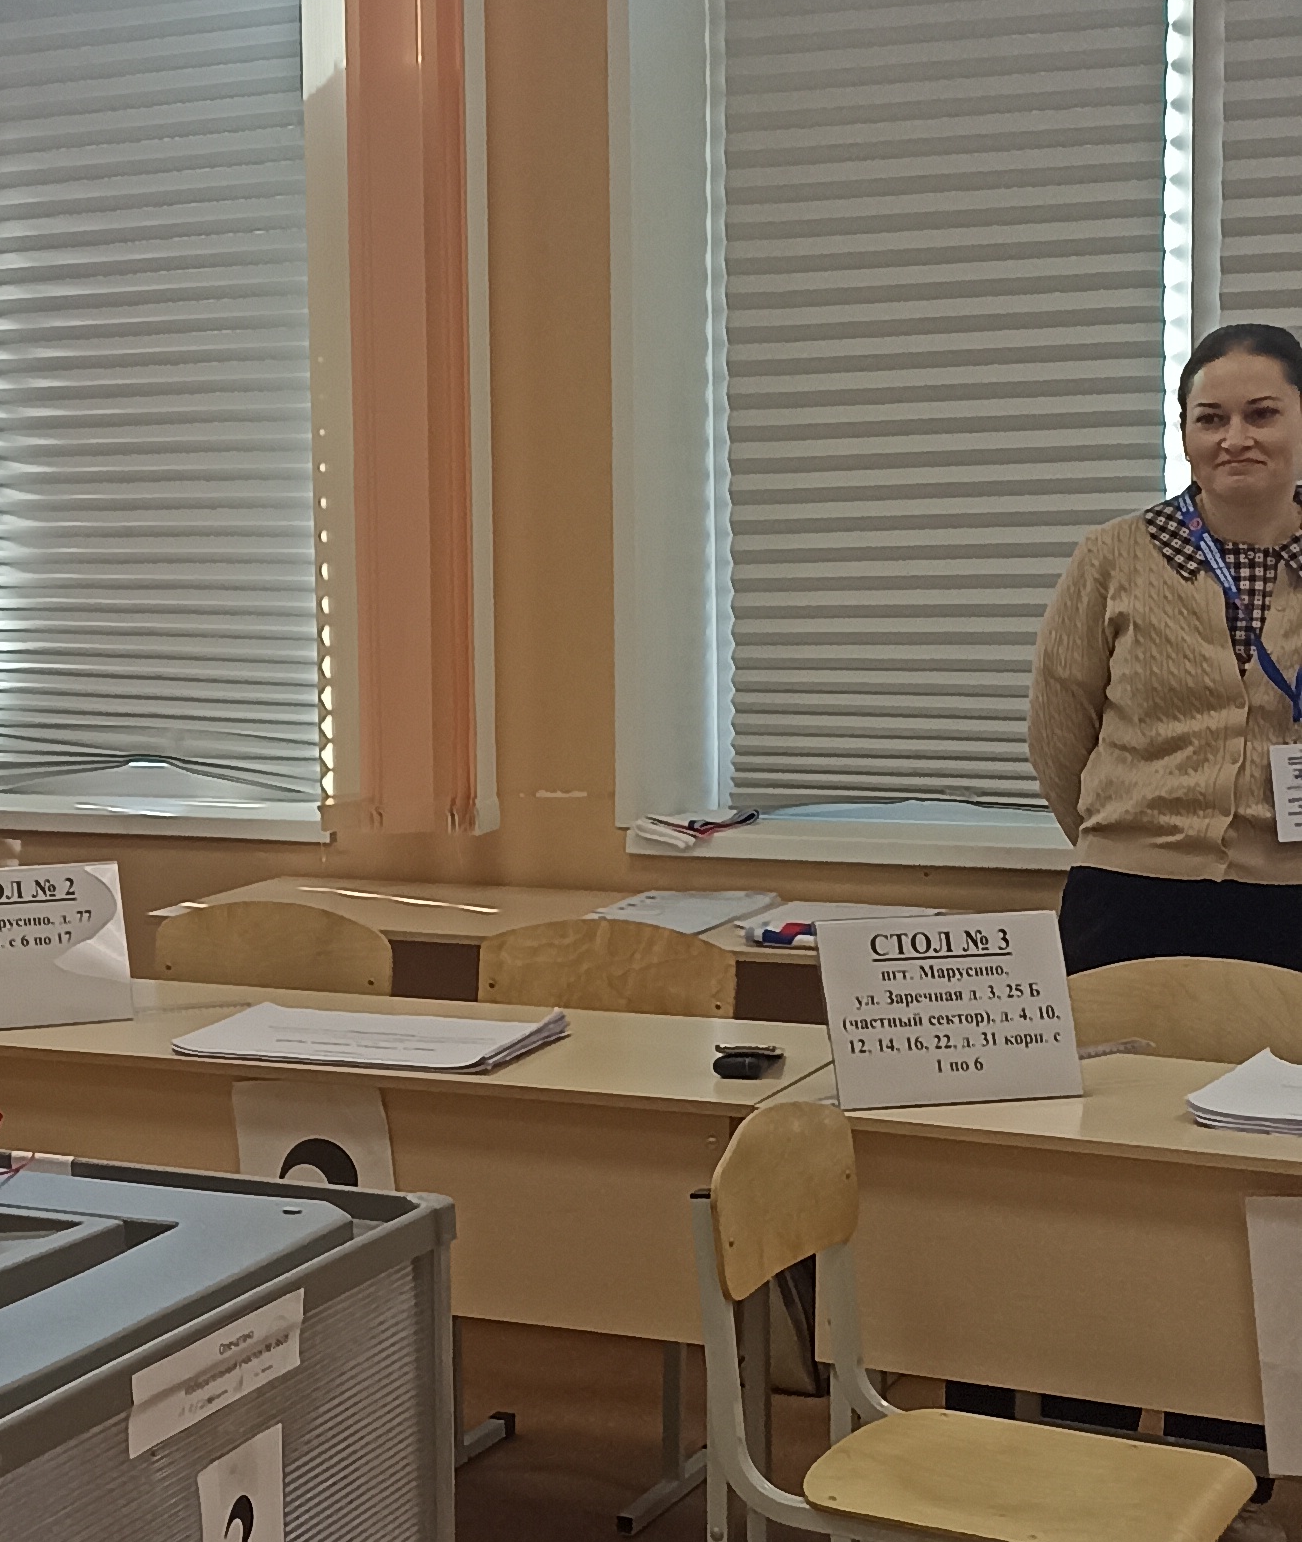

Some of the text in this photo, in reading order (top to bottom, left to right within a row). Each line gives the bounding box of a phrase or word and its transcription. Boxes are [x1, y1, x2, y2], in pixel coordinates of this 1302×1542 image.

[31, 878, 57, 899] №
[64, 877, 76, 896] 2
[76, 909, 92, 923] 77
[20, 934, 30, 948] 6
[34, 936, 52, 946] по
[57, 930, 73, 945] 17
[870, 928, 1010, 957] СТОЛ № 3
[855, 994, 881, 1011] ул.
[884, 989, 963, 1008] Заречная
[1006, 983, 1024, 999] 25
[1028, 982, 1041, 998] Б
[842, 1012, 923, 1034] (частный
[981, 1031, 997, 1047] 31
[937, 1056, 984, 1074] 1 по 6
